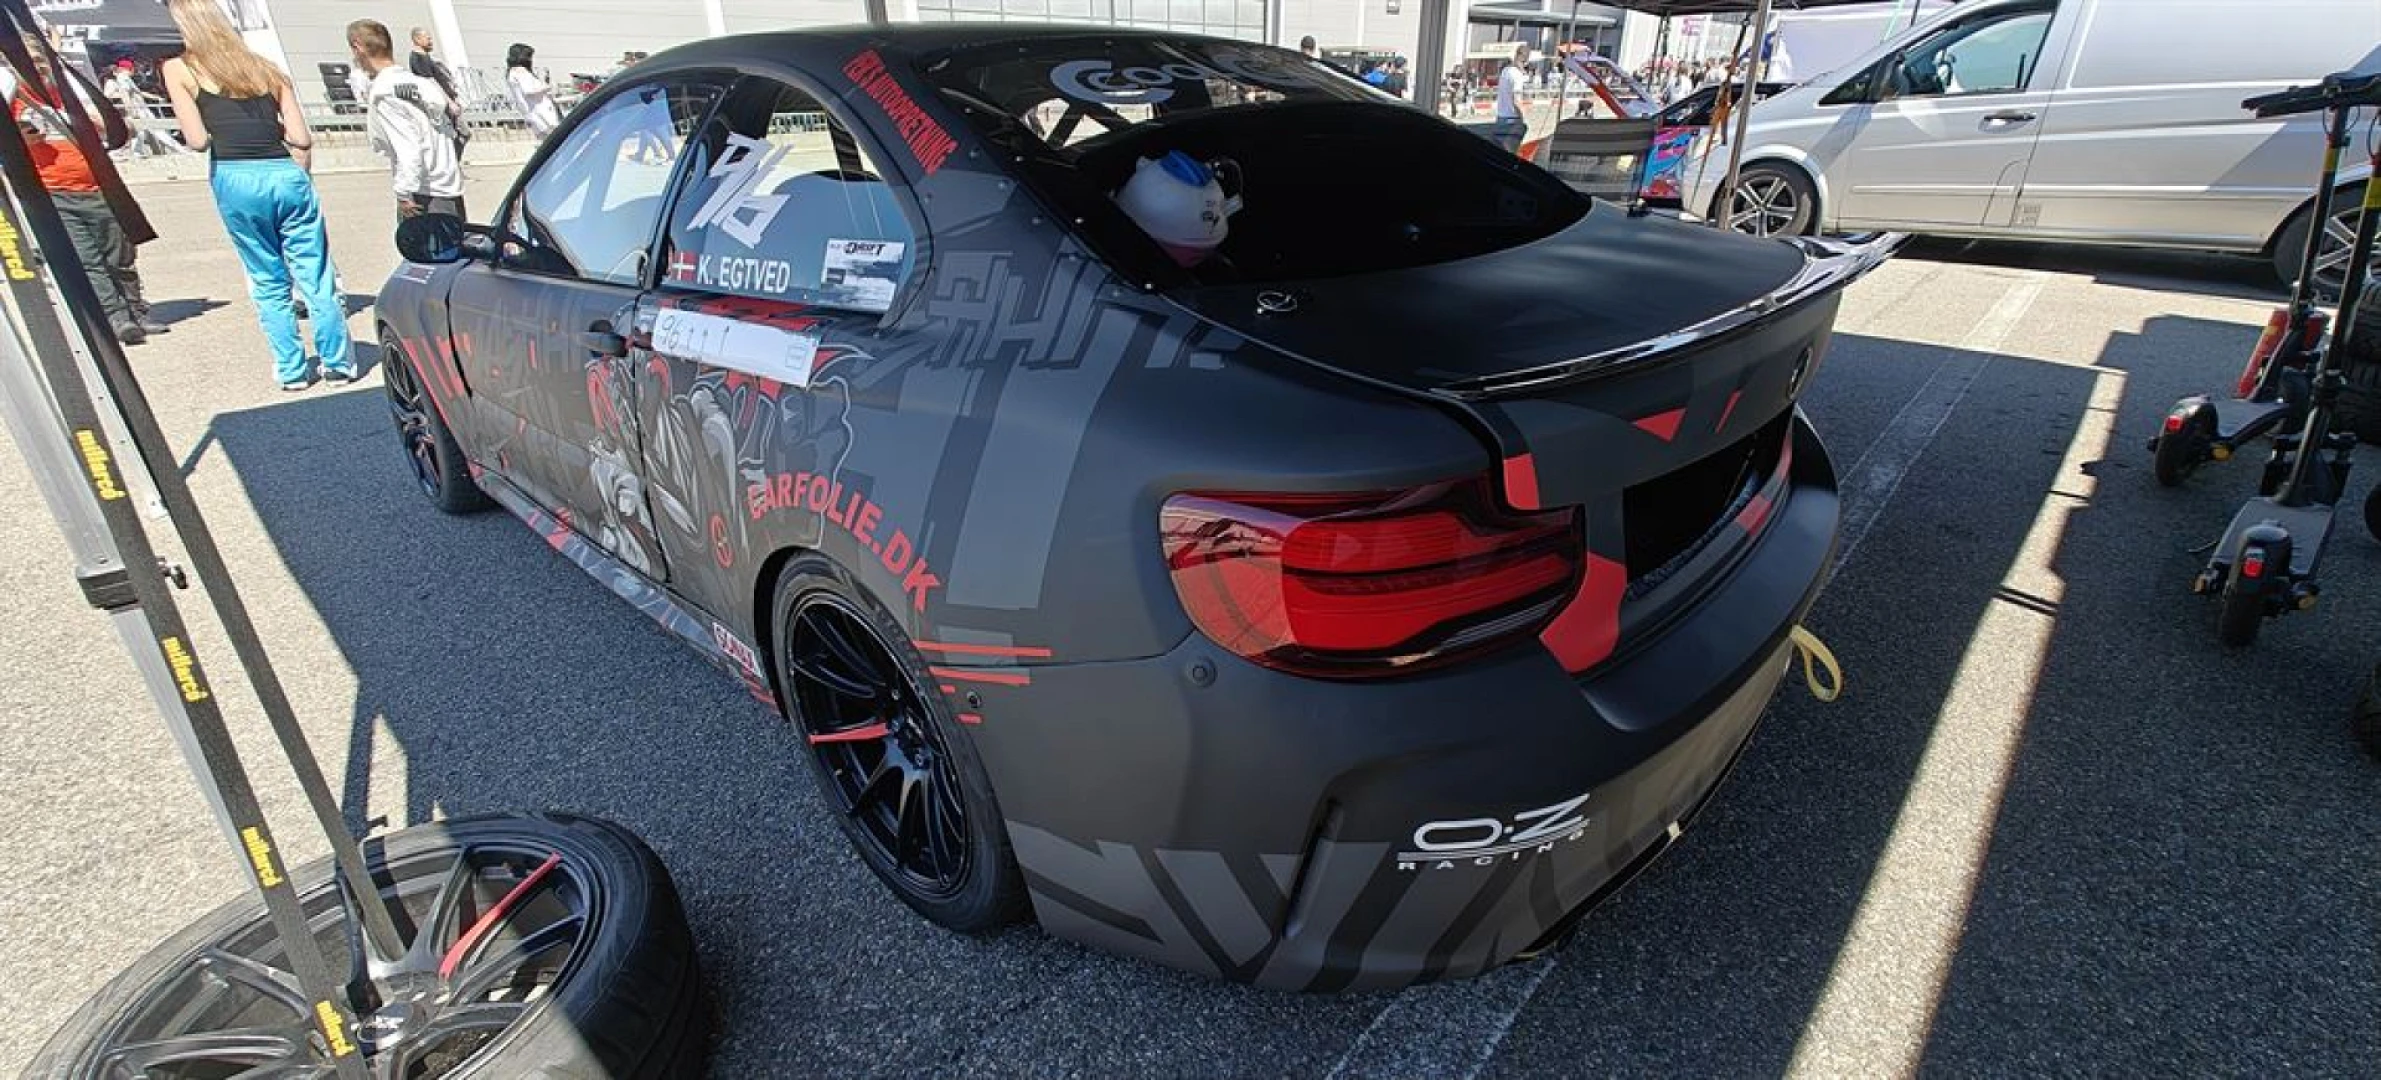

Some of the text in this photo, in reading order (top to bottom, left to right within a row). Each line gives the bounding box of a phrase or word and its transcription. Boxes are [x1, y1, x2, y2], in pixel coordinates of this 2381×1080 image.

[697, 254, 713, 285] K.
[718, 256, 791, 293] EGTVED
[748, 472, 941, 613] CARFOLIE.DK
[1398, 829, 1585, 870] RACING
